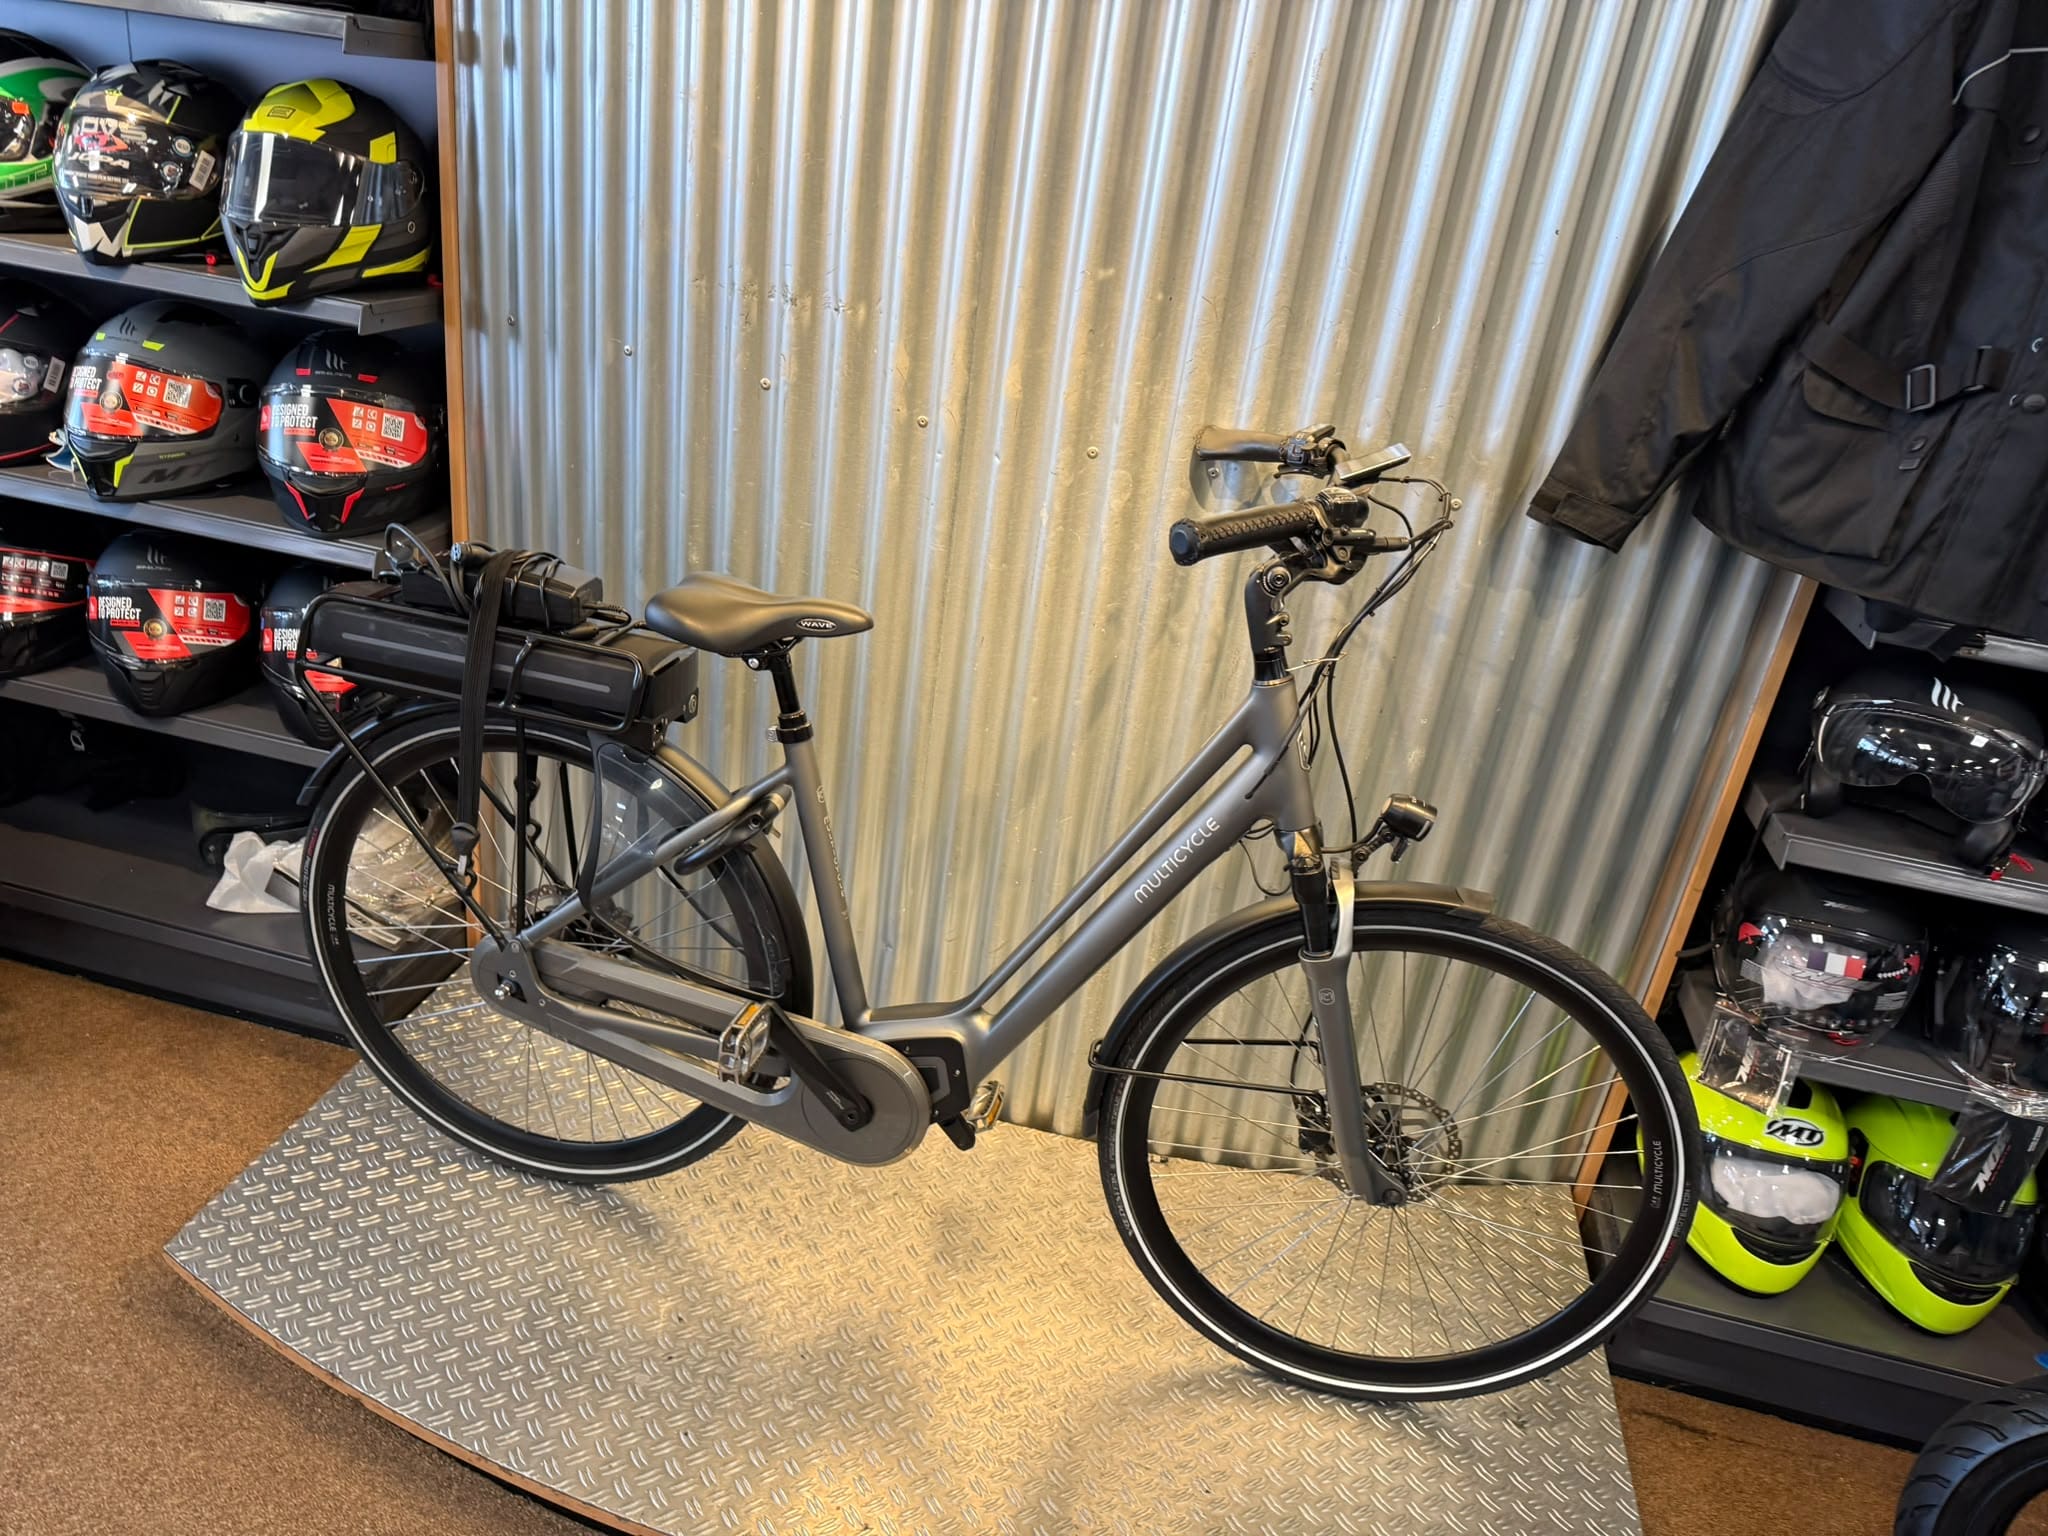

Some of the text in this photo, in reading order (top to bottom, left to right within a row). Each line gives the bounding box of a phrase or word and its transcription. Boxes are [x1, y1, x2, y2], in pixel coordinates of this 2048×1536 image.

[280, 415, 318, 428] PROTECT
[98, 596, 133, 609] DESIGNED
[106, 607, 141, 620] PROTECT
[801, 620, 833, 629] WAVE
[1134, 817, 1220, 904] MULTICYCLE
[327, 884, 337, 932] MULTICYCLE
[1766, 1121, 1824, 1144] MT
[1653, 1140, 1664, 1196] MULTICYCLE
